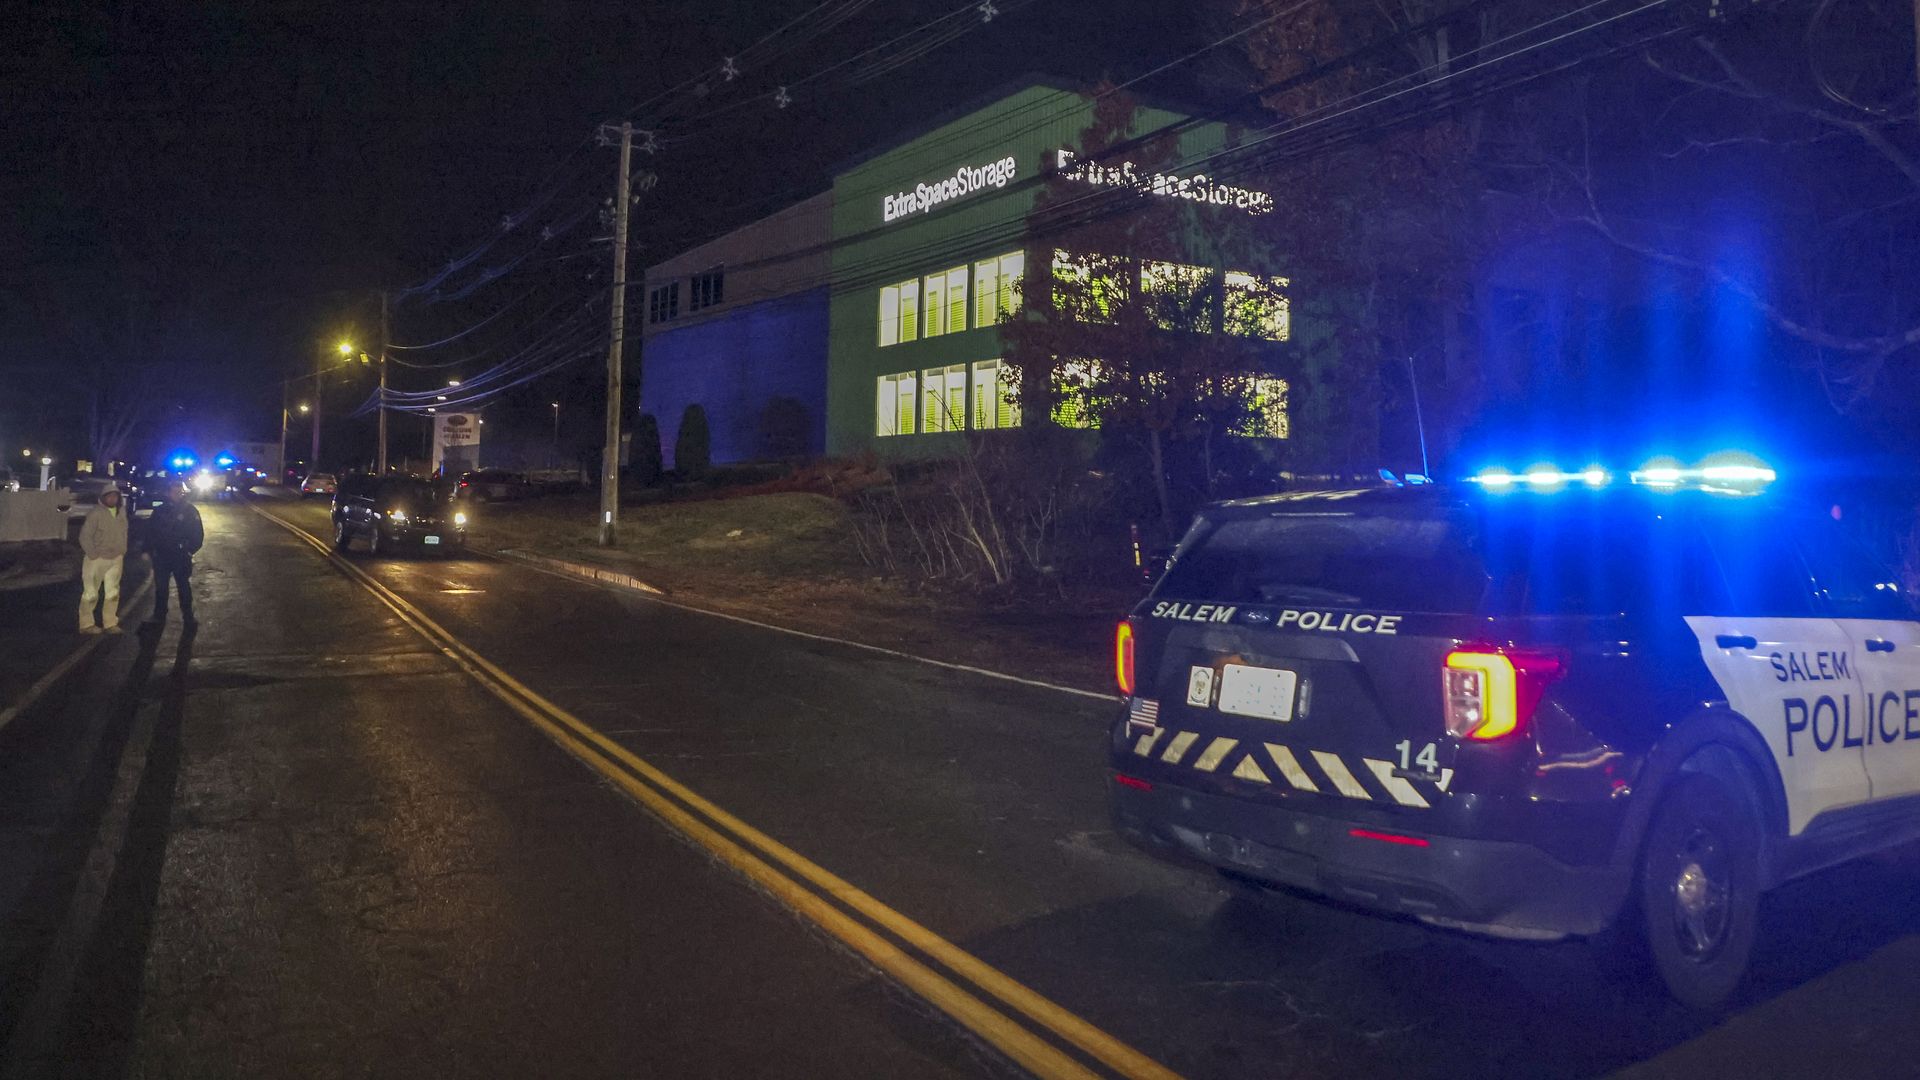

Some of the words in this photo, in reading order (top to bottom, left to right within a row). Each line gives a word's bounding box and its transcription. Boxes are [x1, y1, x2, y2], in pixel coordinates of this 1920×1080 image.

[884, 156, 1016, 221] ExtraSpaceStorage
[1057, 149, 1273, 215] EtraSaceStorage
[1152, 602, 1236, 622] SALEM
[1277, 610, 1402, 634] POLICE
[1771, 652, 1851, 681] SALEM
[1784, 690, 1920, 756] POLICE
[1395, 739, 1439, 773] 14
